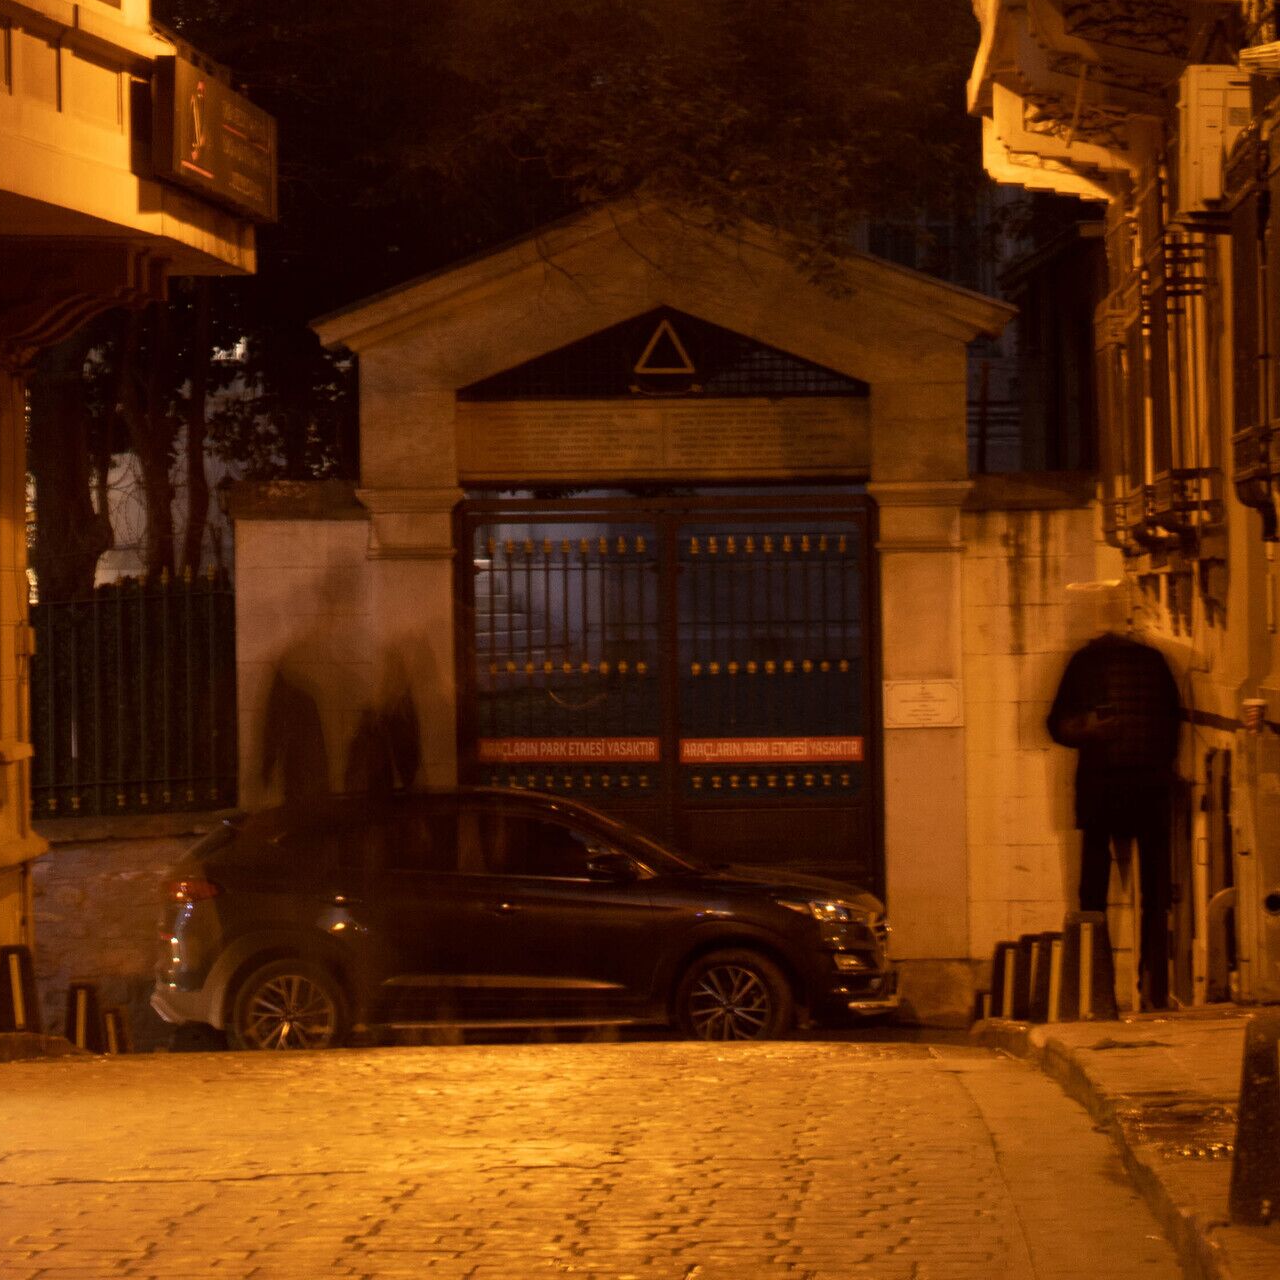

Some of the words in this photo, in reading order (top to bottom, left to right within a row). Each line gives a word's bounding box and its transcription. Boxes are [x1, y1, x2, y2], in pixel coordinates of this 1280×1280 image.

[540, 742, 566, 757] PARK
[570, 739, 605, 757] ETMESİ
[608, 741, 656, 756] YASAKTIR
[683, 742, 740, 760] ARAÇLARIN
[743, 742, 769, 757] PARK
[772, 739, 807, 757] ETMESİ
[810, 741, 858, 756] YASAKTIR
